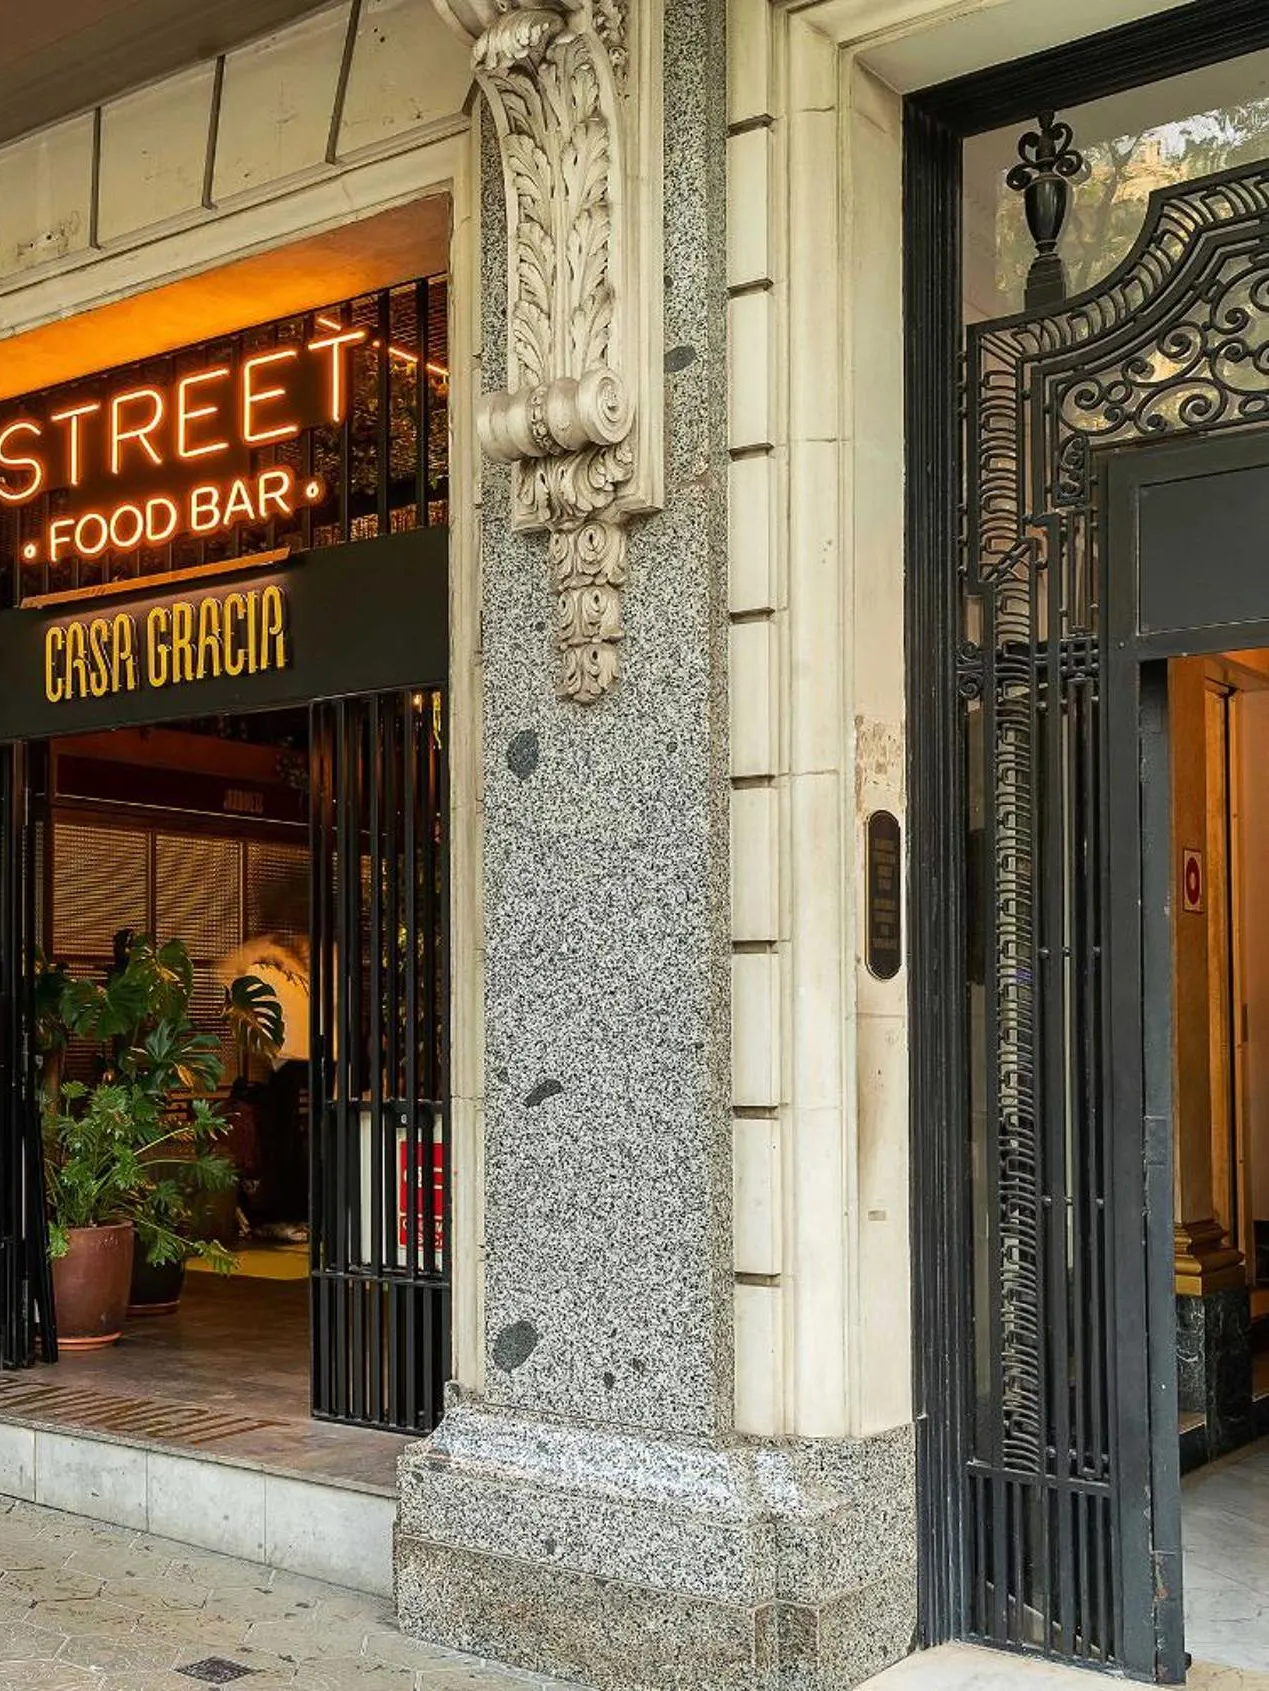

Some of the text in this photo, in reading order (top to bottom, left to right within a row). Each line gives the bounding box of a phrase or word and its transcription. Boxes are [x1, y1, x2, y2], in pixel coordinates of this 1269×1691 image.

[50, 470, 292, 561] FOOD BAR
[45, 585, 287, 703] CASA GRACIA
